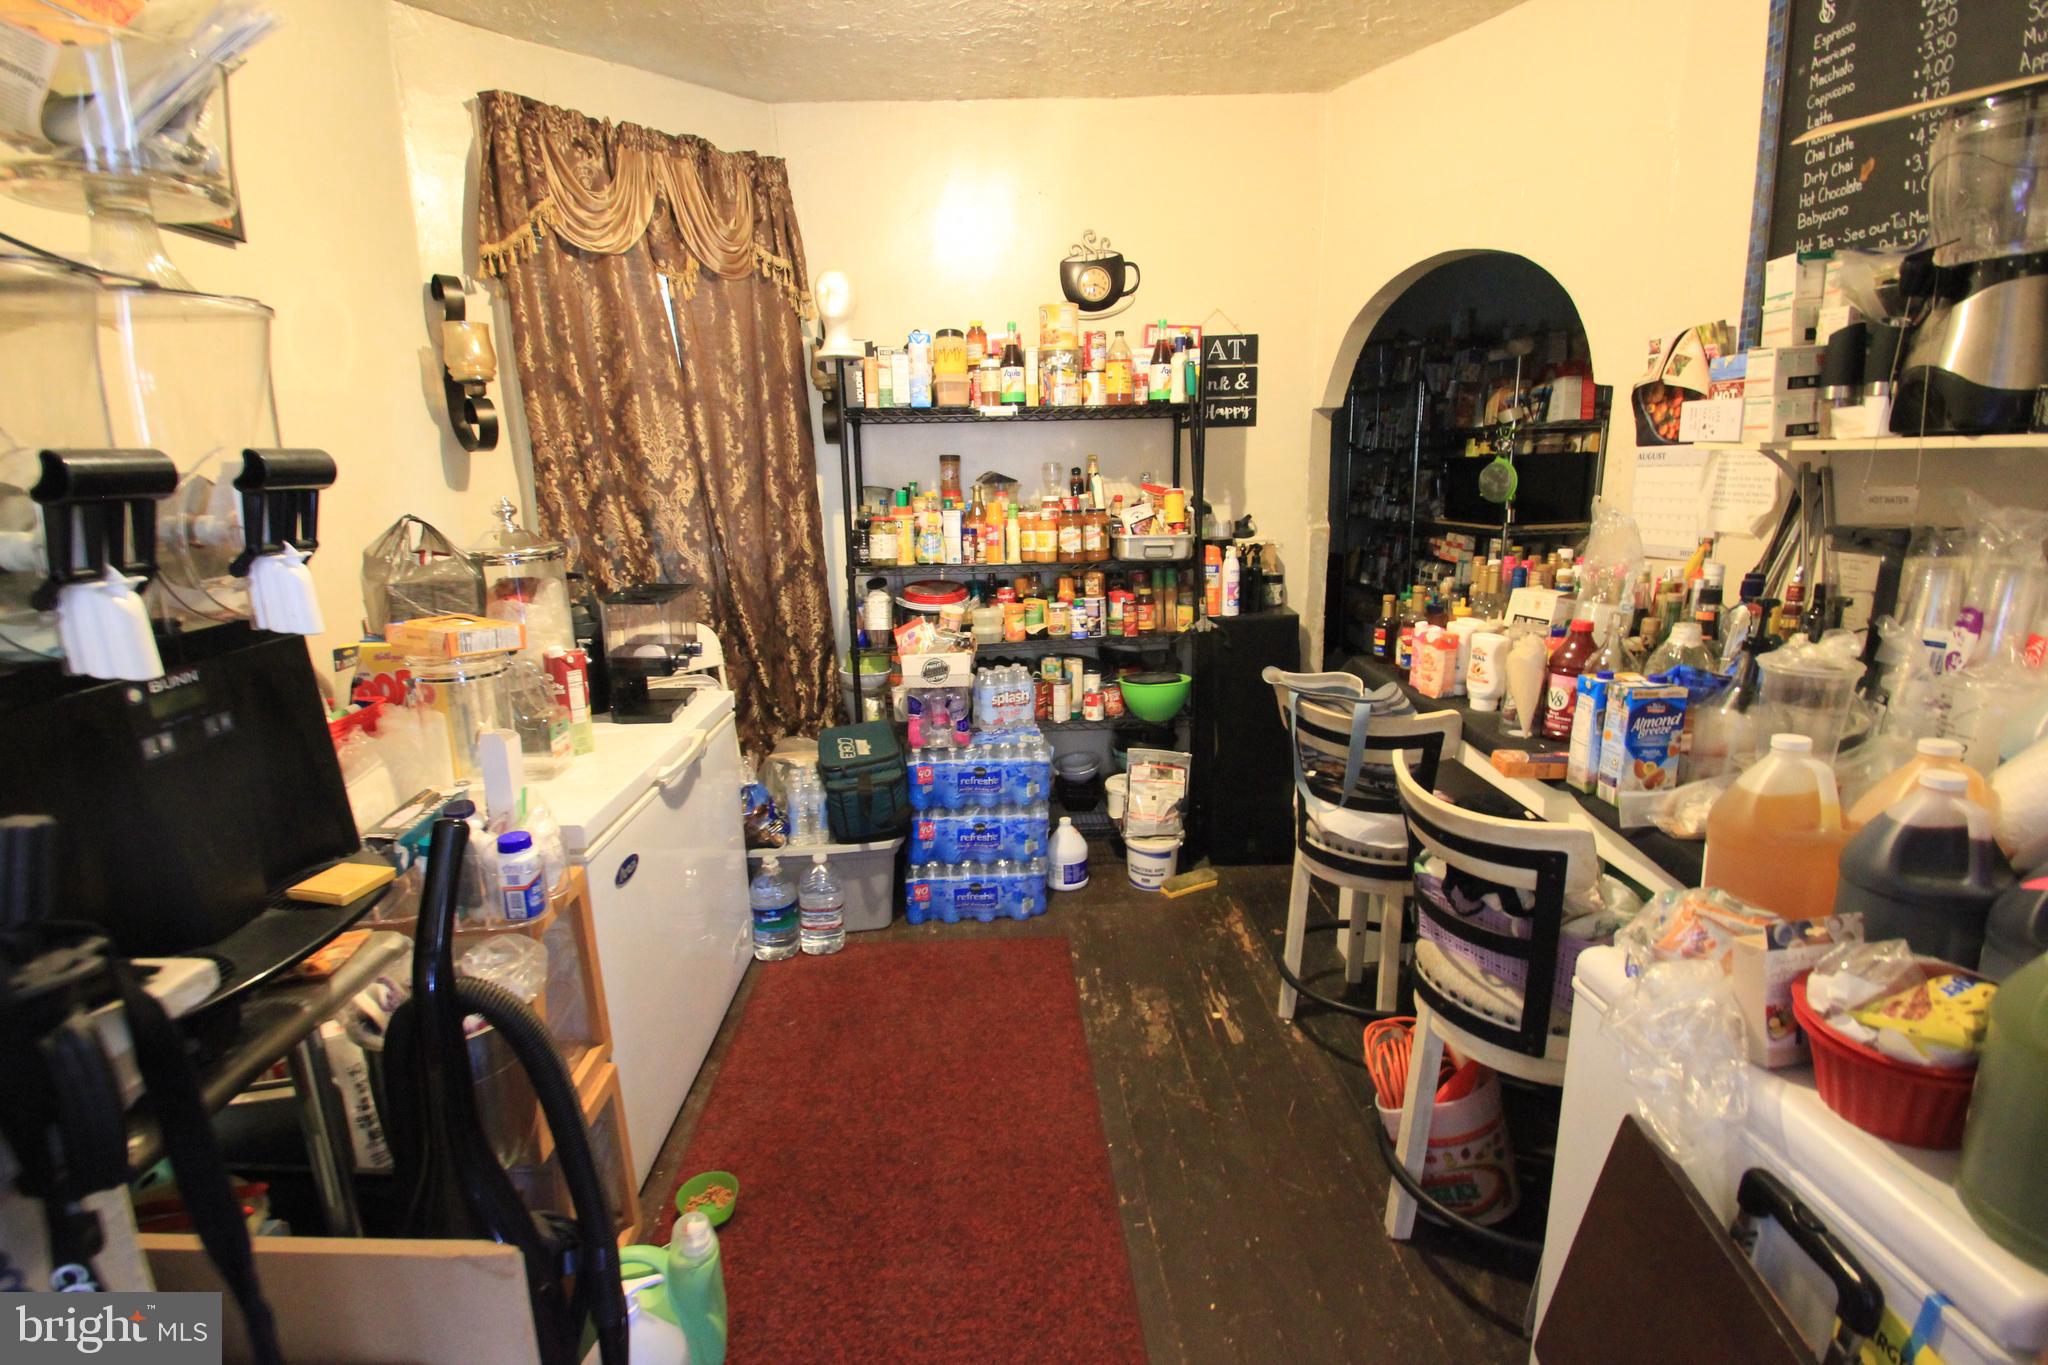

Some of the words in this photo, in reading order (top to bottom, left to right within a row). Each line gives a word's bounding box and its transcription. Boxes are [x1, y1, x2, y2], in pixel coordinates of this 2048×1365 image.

[1814, 22, 1856, 51] Espresso
[1811, 43, 1856, 71] Americano
[1808, 109, 1833, 130] Latte
[1805, 147, 1826, 165] Chai
[1829, 135, 1854, 157] Latte
[1803, 168, 1828, 188] Dirty
[1831, 157, 1853, 177] Chai
[1800, 191, 1815, 208] Hot
[1819, 178, 1863, 203] Chocolate
[1798, 205, 1849, 229] Babyccino
[1796, 239, 1814, 253] Hot
[1817, 233, 1834, 250] Tea
[1843, 228, 1866, 243] See
[1869, 221, 1890, 236] our
[1208, 339, 1247, 360] AT
[1235, 373, 1249, 389] &
[1206, 403, 1251, 420] Happy
[148, 670, 199, 693] BUNN
[992, 690, 1030, 705] splash
[1550, 690, 1563, 707] V8
[1631, 712, 1683, 733] Almond
[918, 769, 932, 778] 40
[920, 825, 932, 834] 40
[915, 886, 928, 895] 40
